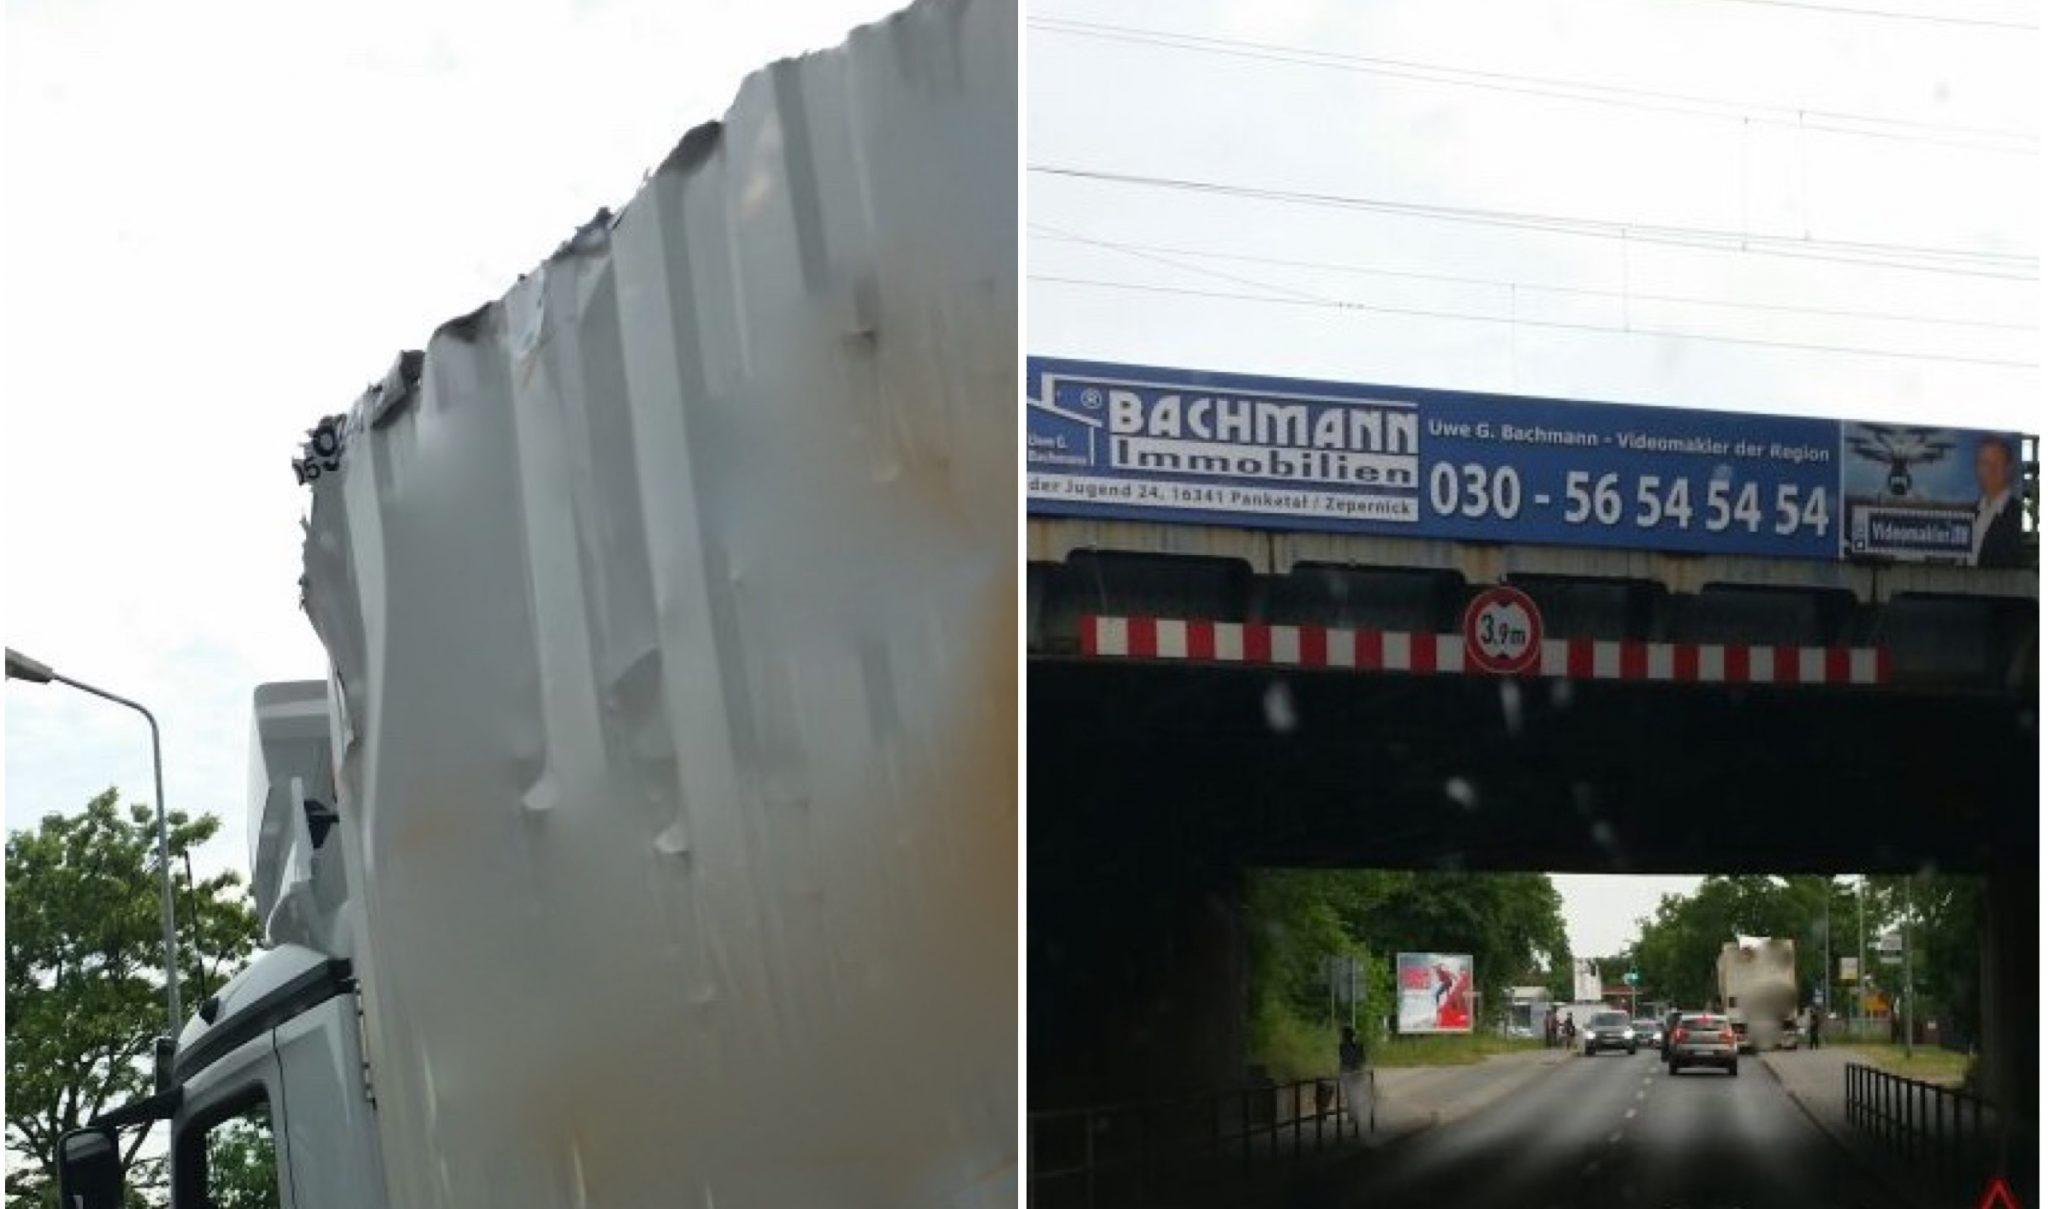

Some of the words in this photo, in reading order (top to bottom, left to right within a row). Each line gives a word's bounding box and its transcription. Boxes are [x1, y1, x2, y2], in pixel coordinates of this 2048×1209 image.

[1108, 389, 1419, 454] BACHMANN
[1428, 418, 1472, 437] Uwe
[1475, 422, 1495, 439] G.
[1501, 424, 1599, 447] Bachmann
[1616, 432, 1729, 455] Videomakler
[1734, 440, 1763, 458] der
[1770, 443, 1830, 463] Region
[1117, 439, 1412, 484] Immobilien
[1029, 477, 1061, 493] der
[1065, 479, 1132, 499] Jugend
[1172, 485, 1223, 504] 16341
[1231, 489, 1307, 509] Panketal
[1325, 497, 1410, 514] Zepernick
[1430, 460, 1521, 519] 030
[1564, 470, 1623, 525] 56
[1636, 475, 1693, 529] 54
[1705, 479, 1761, 533] 54
[1774, 483, 1830, 537] 54
